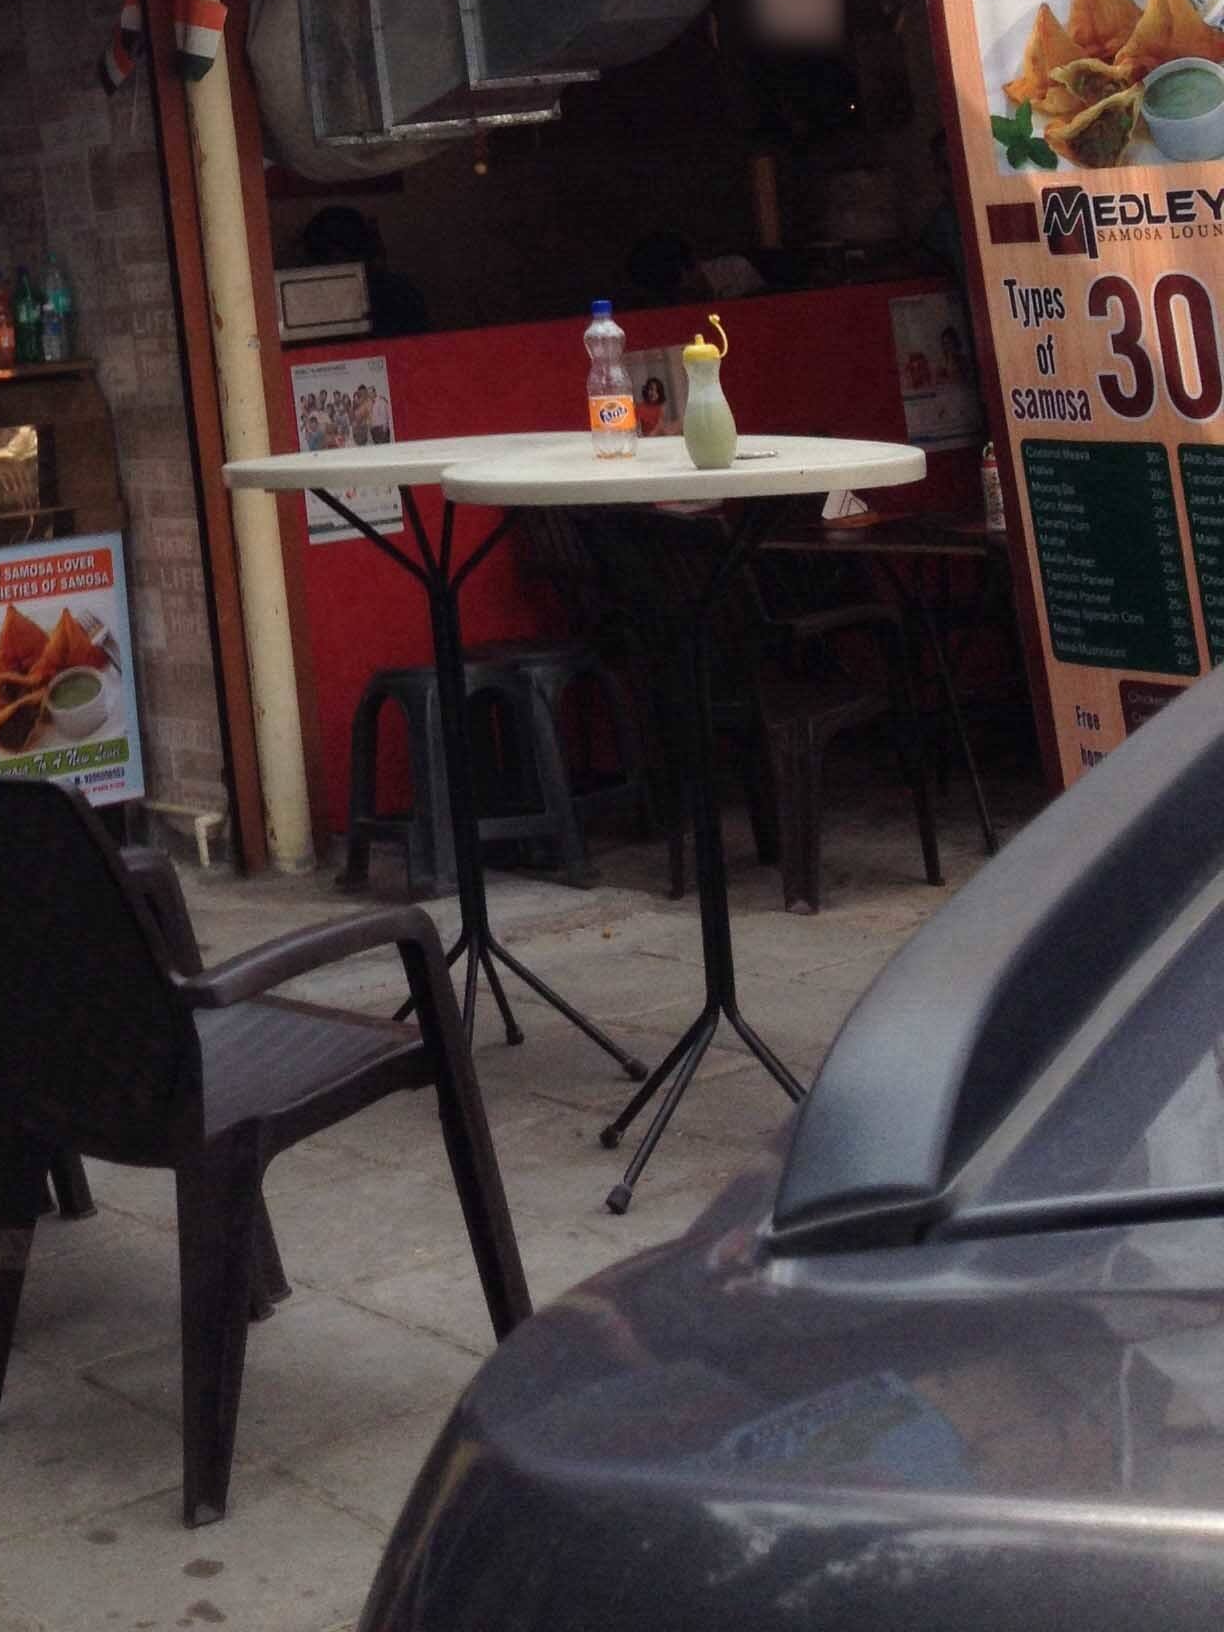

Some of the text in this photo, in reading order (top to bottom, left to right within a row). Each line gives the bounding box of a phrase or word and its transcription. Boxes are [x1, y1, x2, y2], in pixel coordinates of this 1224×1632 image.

[1042, 186, 1224, 259] MEDLEY
[1097, 228, 1163, 242] SAMOSA
[1004, 278, 1066, 326] Types
[1036, 334, 1056, 376] of
[1088, 273, 1223, 422] 30
[5, 561, 54, 581] SAMOSA
[57, 555, 95, 572] LOVER
[42, 579, 57, 594] OF
[61, 571, 109, 589] SAMOSA
